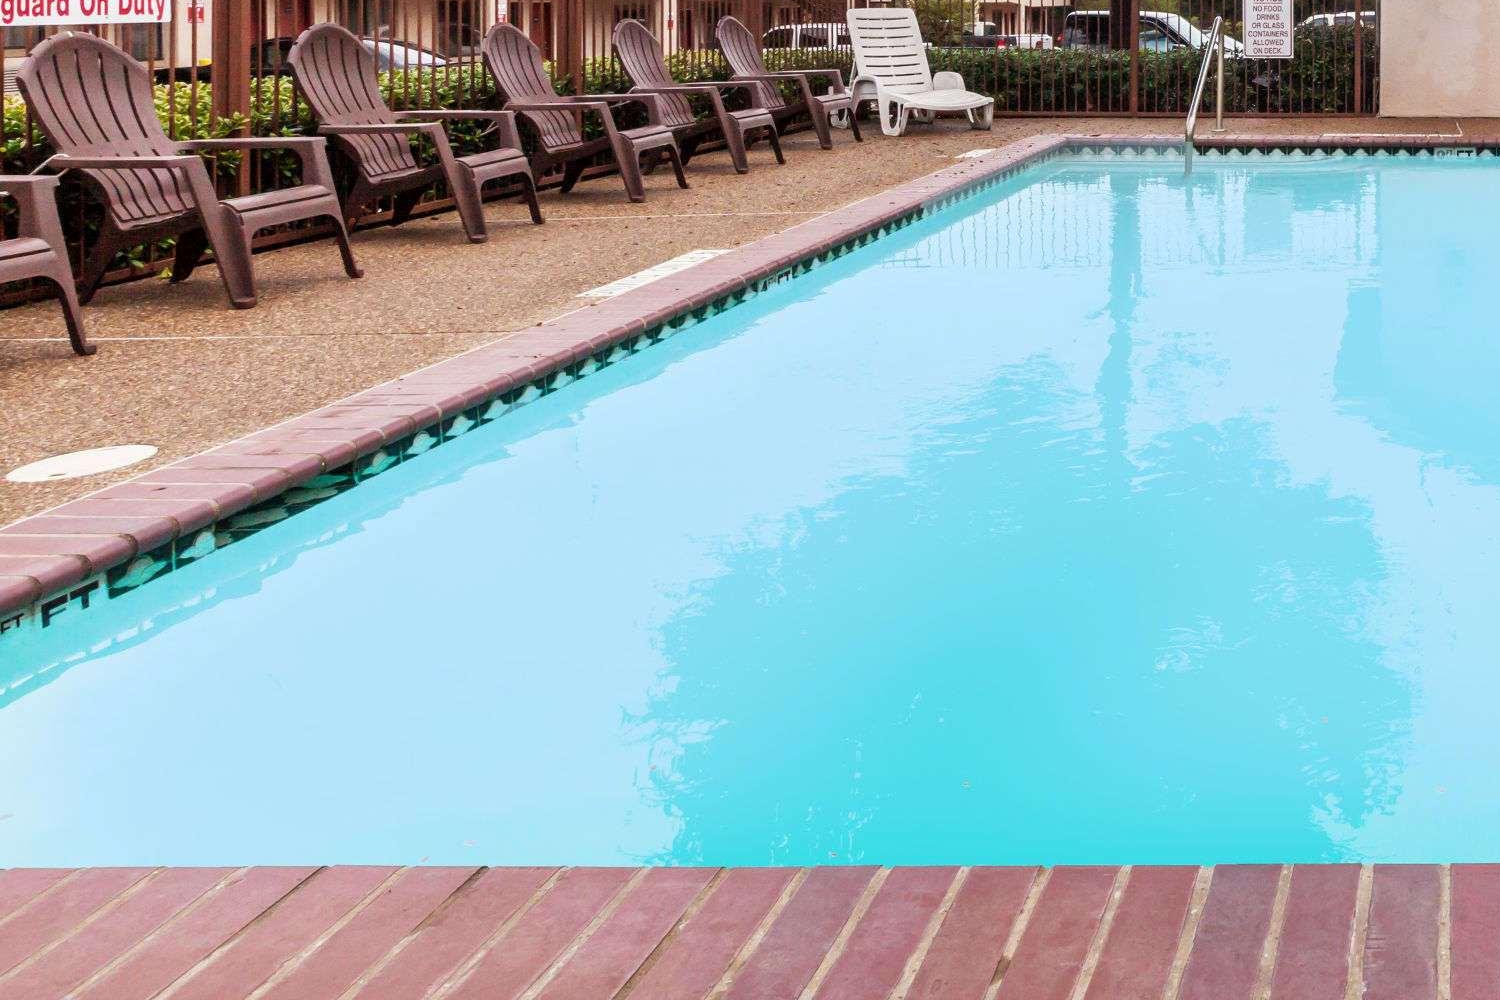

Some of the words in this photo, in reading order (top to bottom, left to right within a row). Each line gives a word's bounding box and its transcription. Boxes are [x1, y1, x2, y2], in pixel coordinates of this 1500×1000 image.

[1253, 47, 1263, 55] ON
[1264, 47, 1281, 55] DECK
[41, 580, 99, 628] FT
